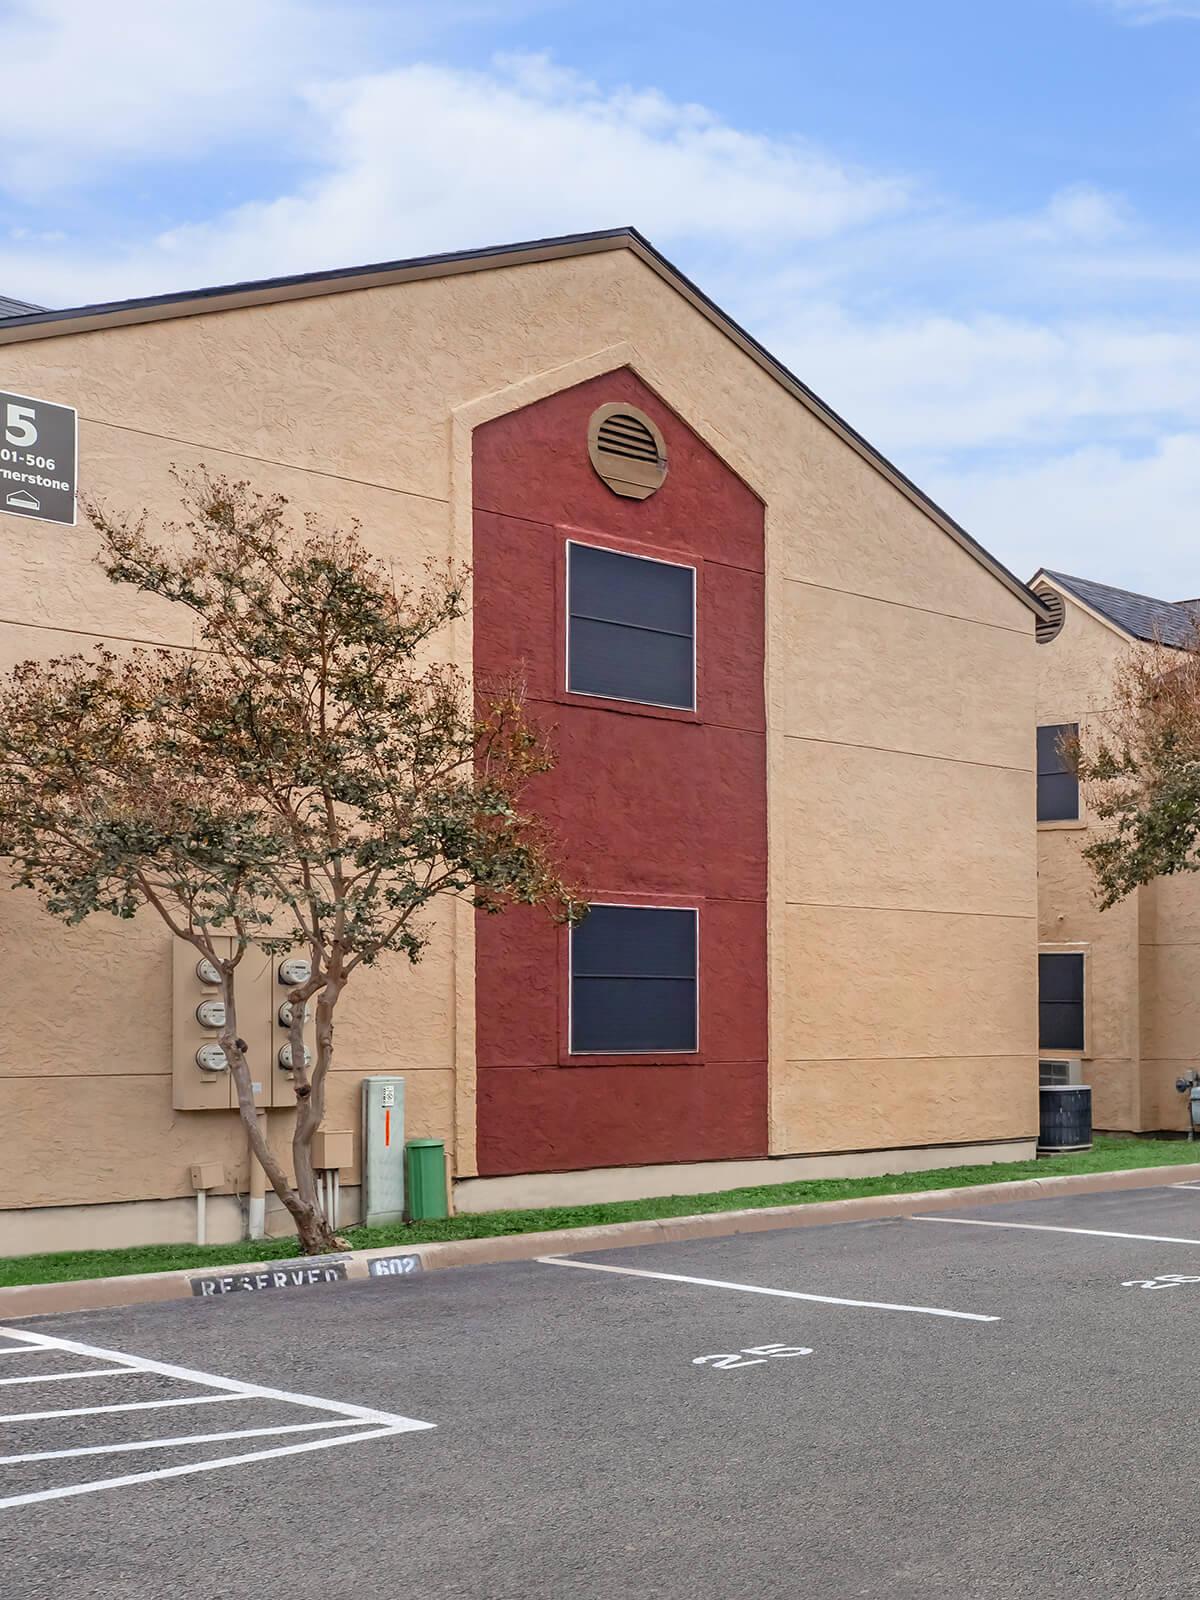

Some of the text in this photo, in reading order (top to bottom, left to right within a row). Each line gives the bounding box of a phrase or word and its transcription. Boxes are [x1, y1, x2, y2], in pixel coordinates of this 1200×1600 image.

[5, 403, 38, 447] 5
[0, 449, 56, 471] 01-506
[0, 468, 70, 491] nerstone
[375, 1257, 416, 1276] 602
[692, 1343, 814, 1369] 25
